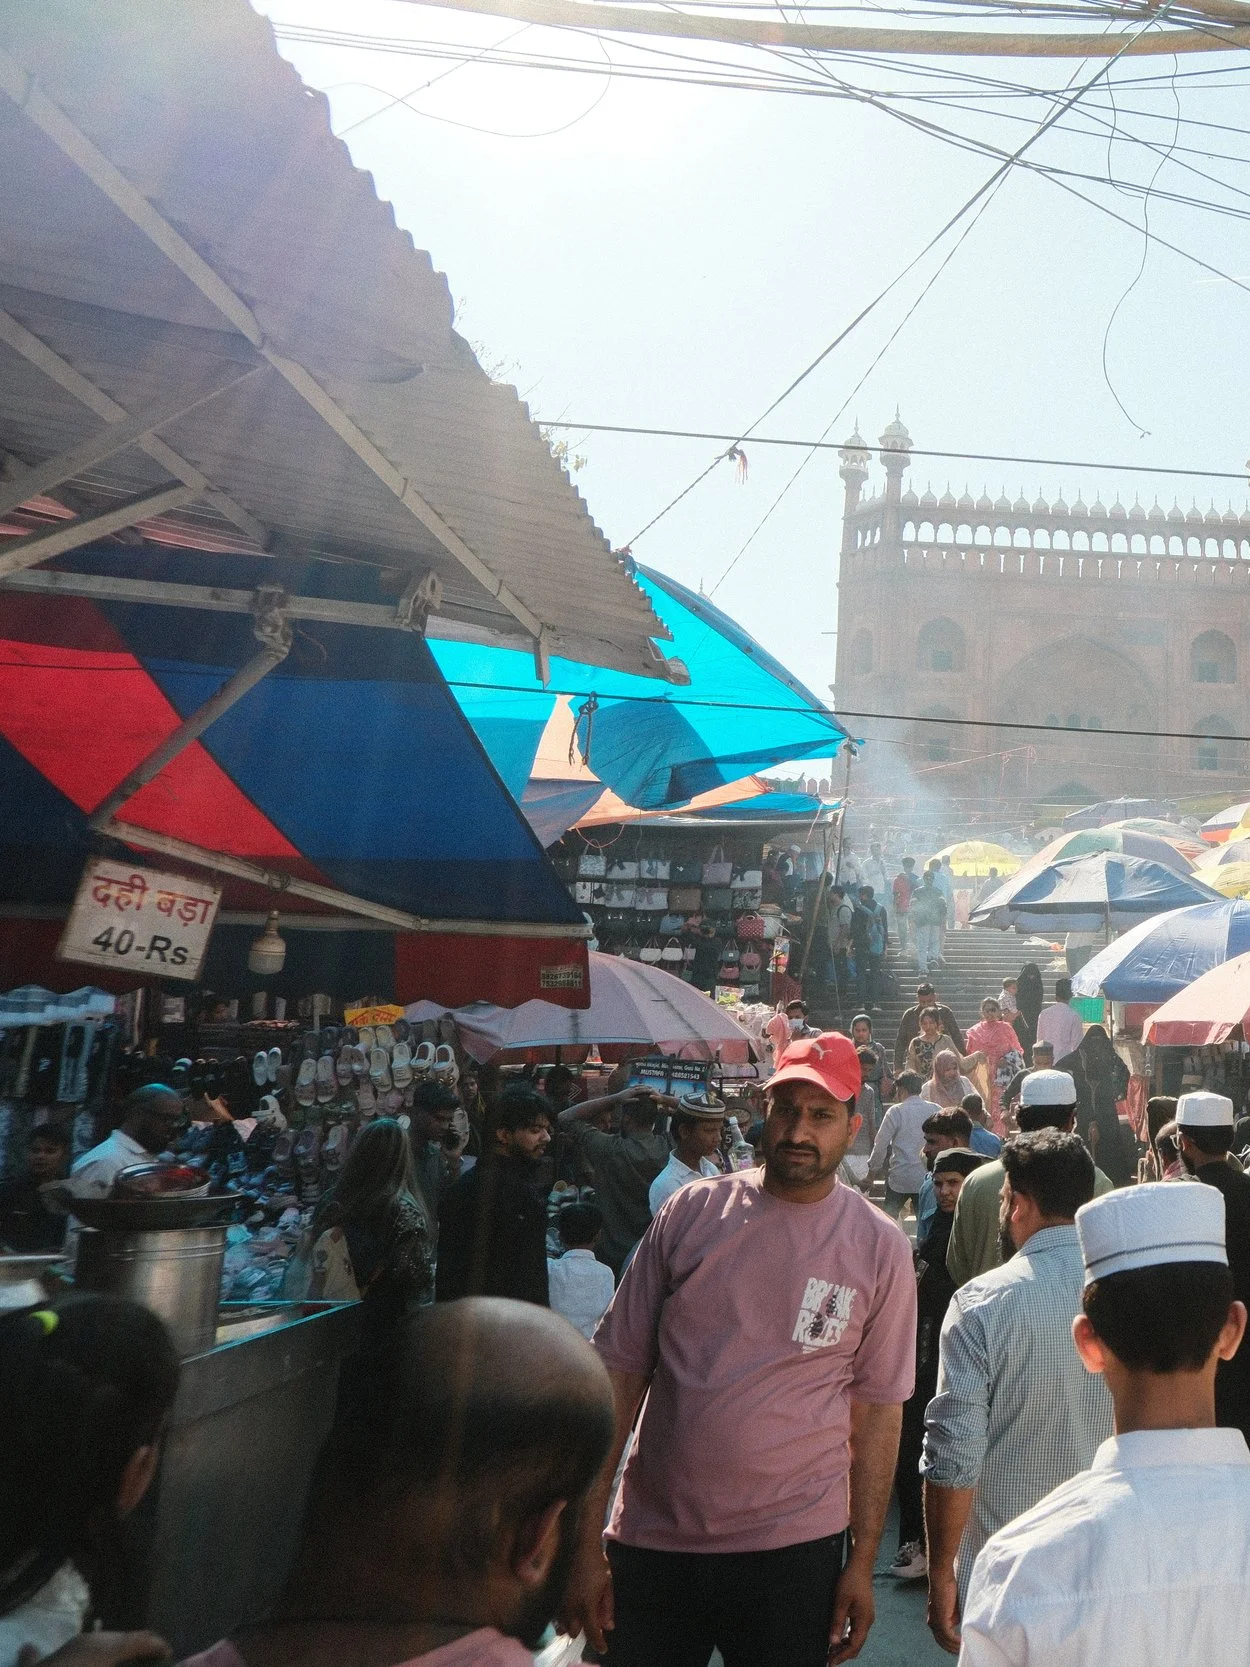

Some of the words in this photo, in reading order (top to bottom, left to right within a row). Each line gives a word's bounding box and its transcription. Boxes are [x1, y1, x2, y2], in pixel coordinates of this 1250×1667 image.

[92, 874, 149, 912] दही
[157, 890, 213, 927] बड़ा
[92, 926, 188, 965] 40-Rs
